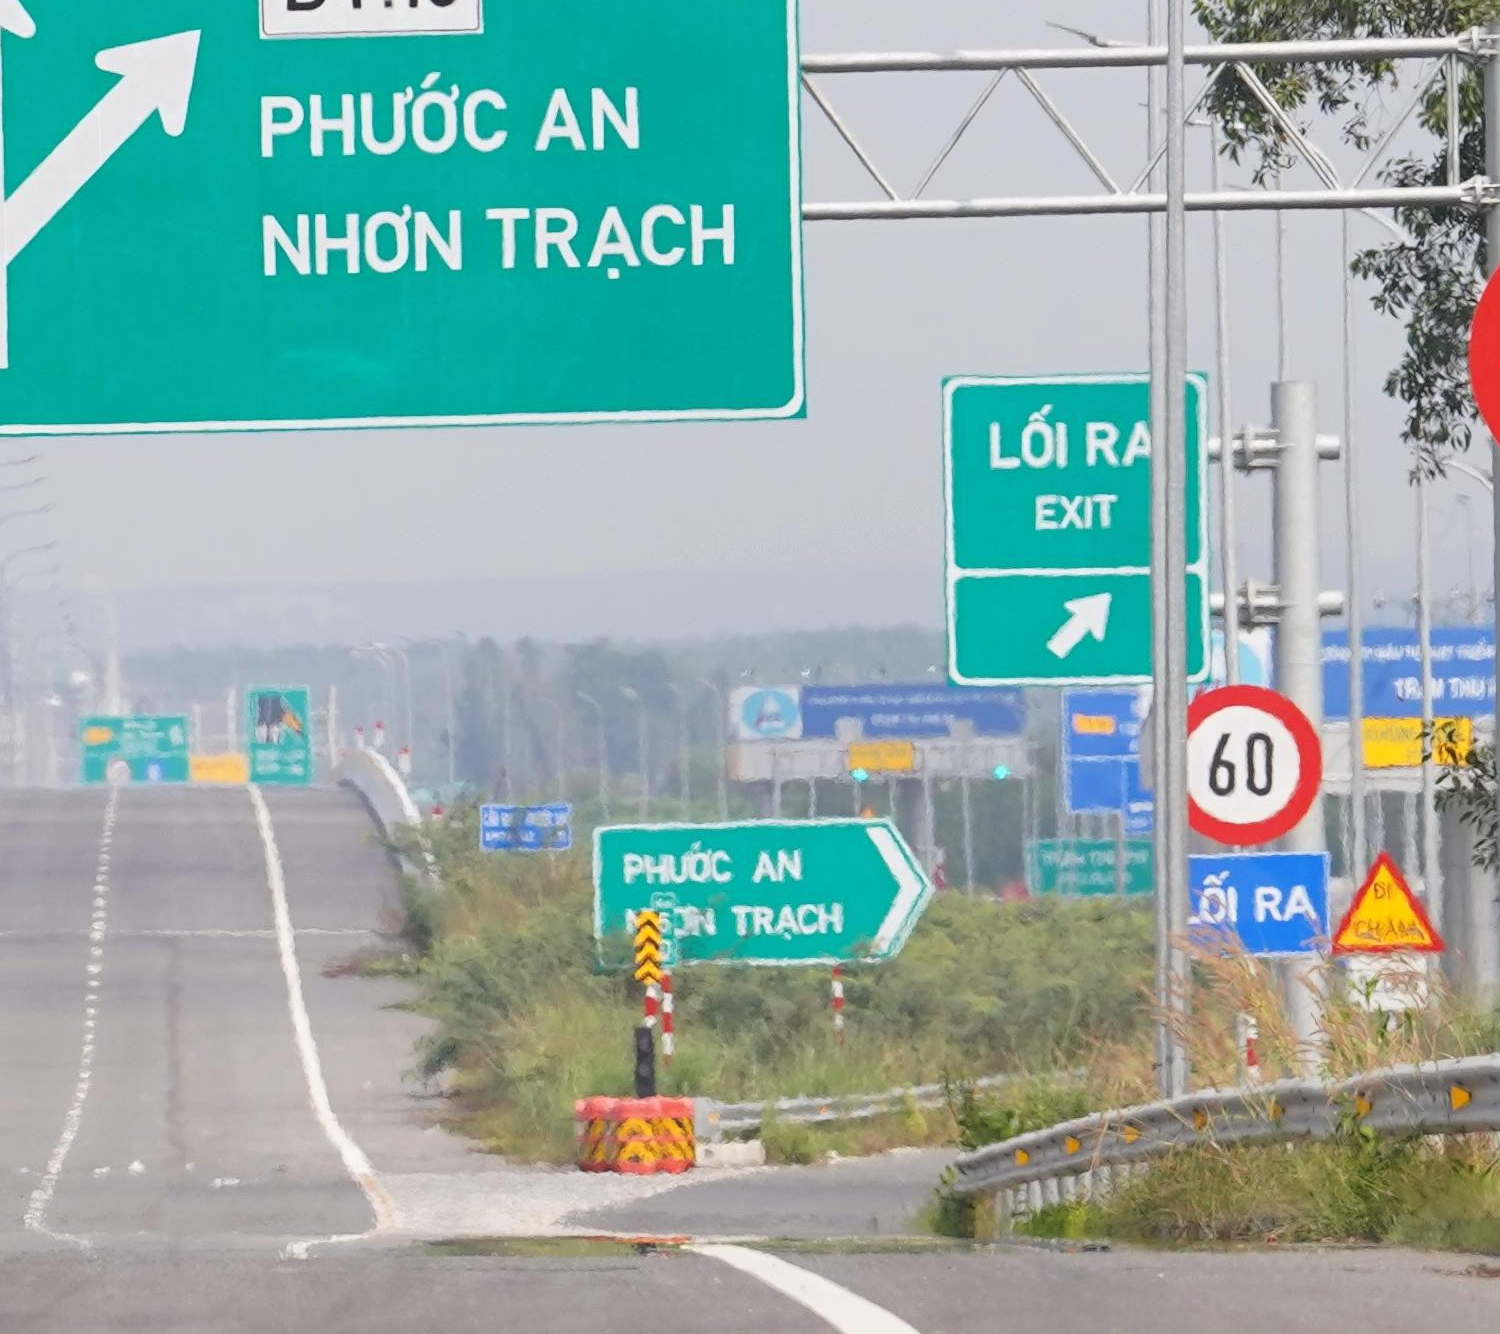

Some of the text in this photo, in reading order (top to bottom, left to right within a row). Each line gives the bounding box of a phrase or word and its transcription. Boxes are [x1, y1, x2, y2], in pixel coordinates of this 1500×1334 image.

[261, 72, 640, 156] PHƯỚC AN
[262, 204, 736, 280] NHƠN TRẠCH
[988, 403, 1068, 469] LỐI
[1034, 493, 1118, 531] EXIT
[1208, 732, 1274, 796] 60
[623, 841, 804, 884] PHƯỚC AN
[730, 902, 844, 940] TRẠCH
[1255, 885, 1319, 923] RA
